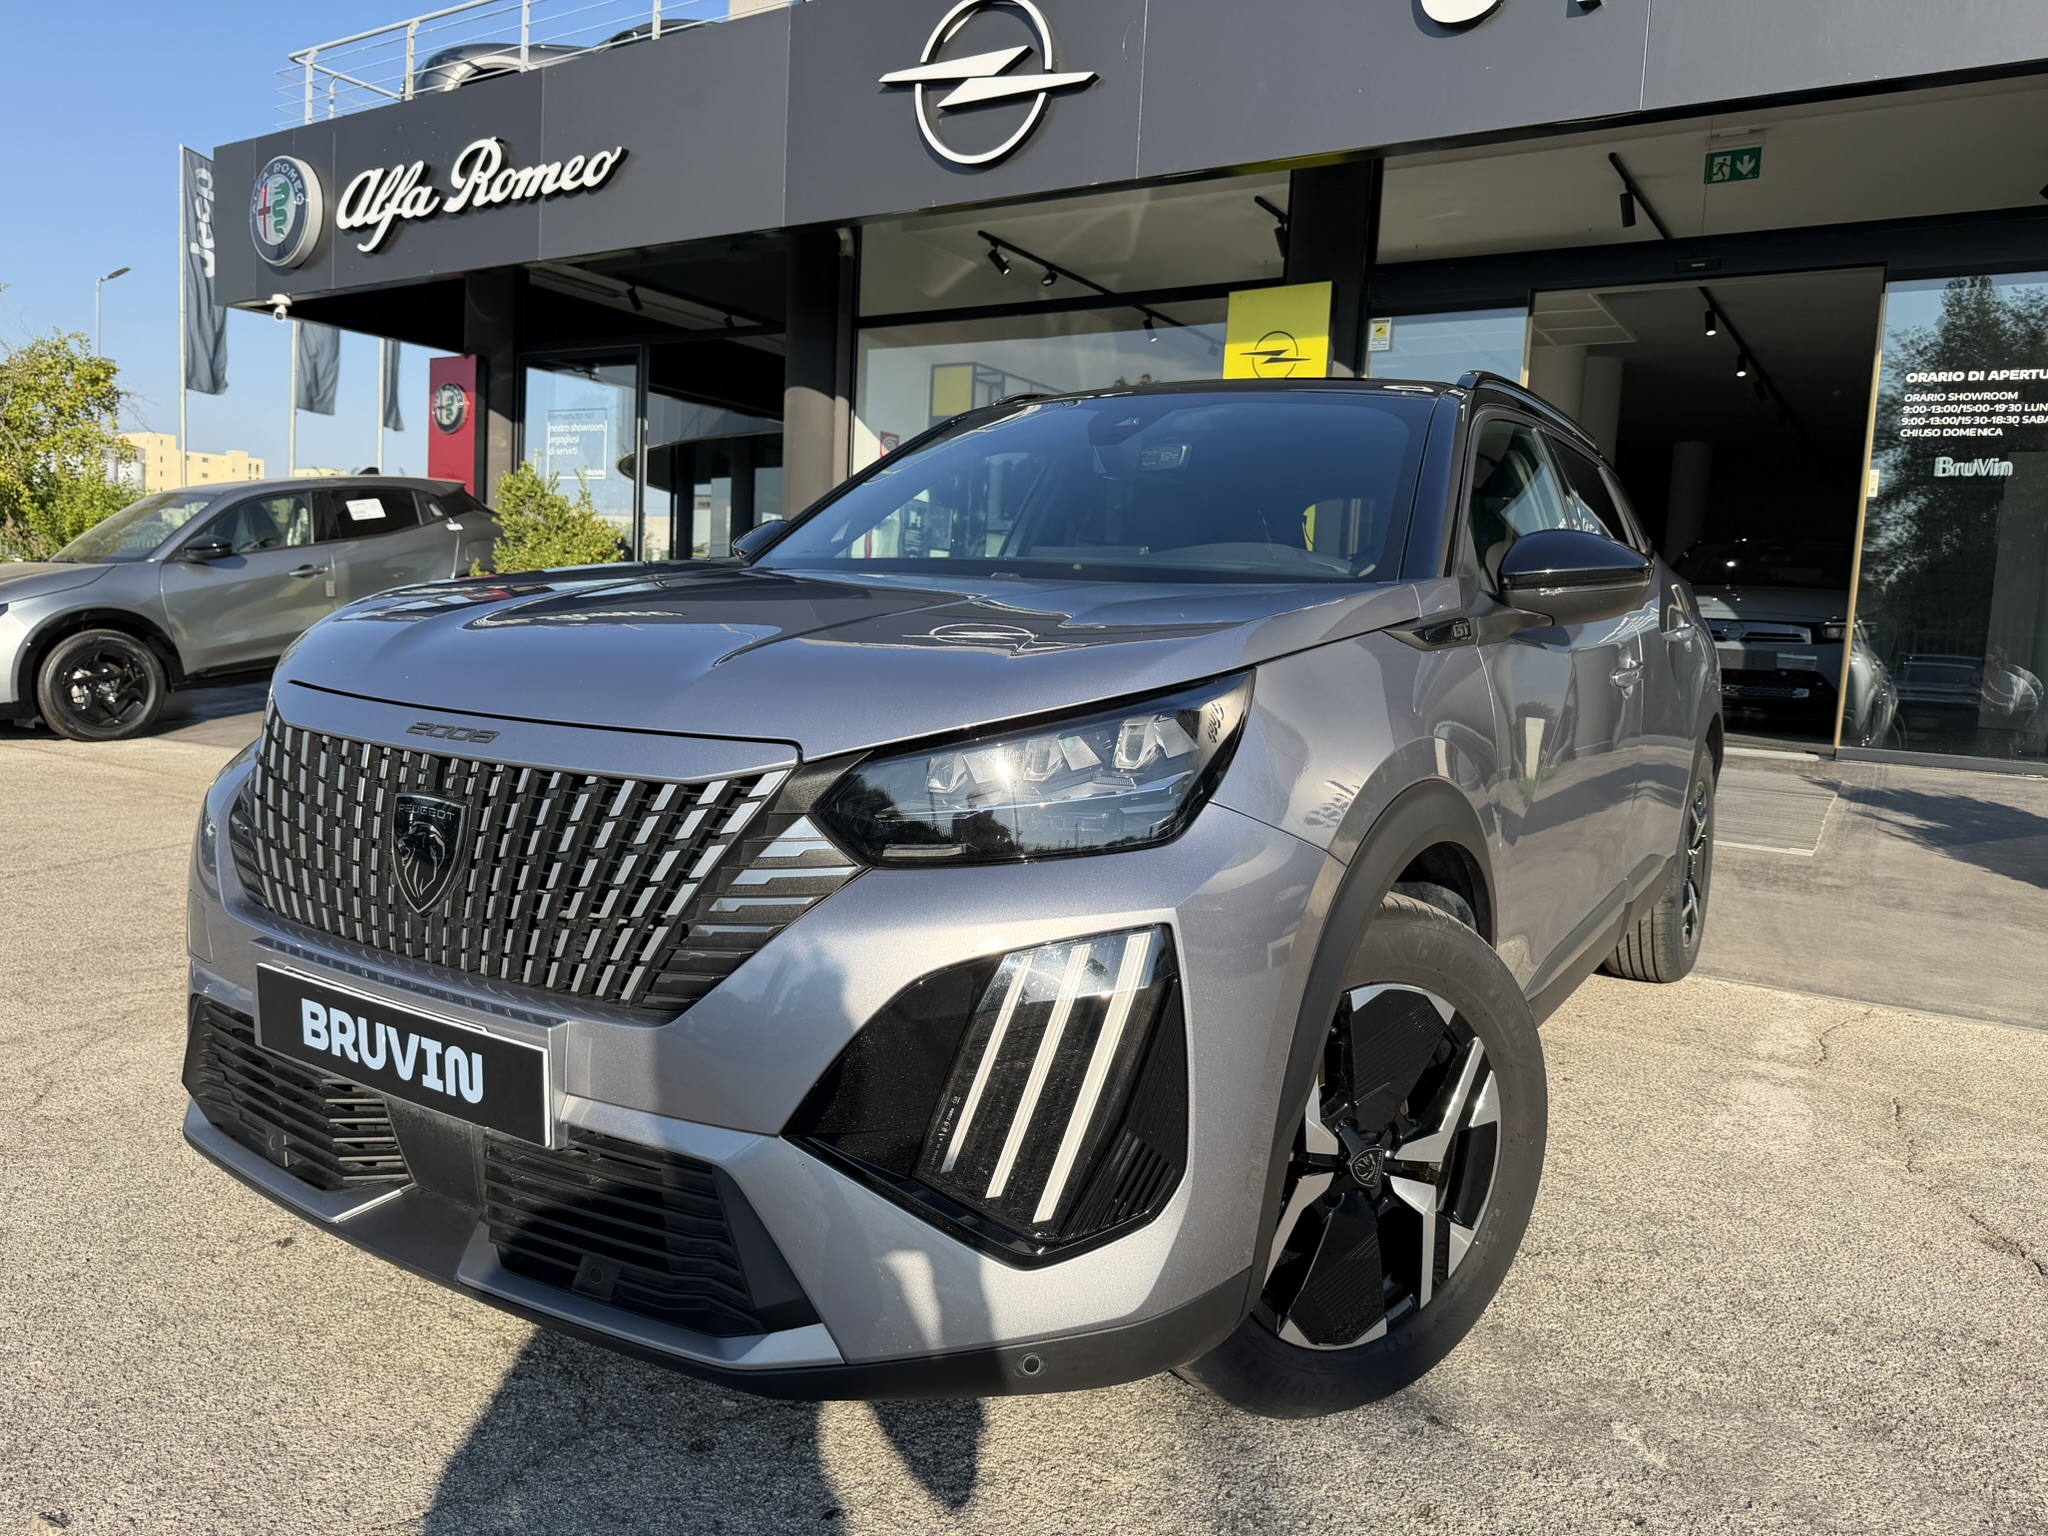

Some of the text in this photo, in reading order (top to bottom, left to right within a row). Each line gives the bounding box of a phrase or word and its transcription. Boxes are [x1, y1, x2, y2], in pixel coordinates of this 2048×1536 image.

[273, 162, 305, 206] ROMEO
[336, 136, 622, 252] Alfa Romeo
[190, 167, 215, 278] Jeep
[1905, 371, 1965, 383] ORARIO
[1968, 370, 1985, 382] DI
[1904, 391, 2019, 402] ORARIO SHOWROOM
[549, 423, 570, 433] nostro
[1900, 427, 2004, 438] CHIUSO DOMENICA
[1933, 456, 2014, 477] BruVin
[406, 721, 500, 744] 2008
[397, 803, 455, 821] PEUGEOT
[301, 998, 484, 1104] BRUVIN
